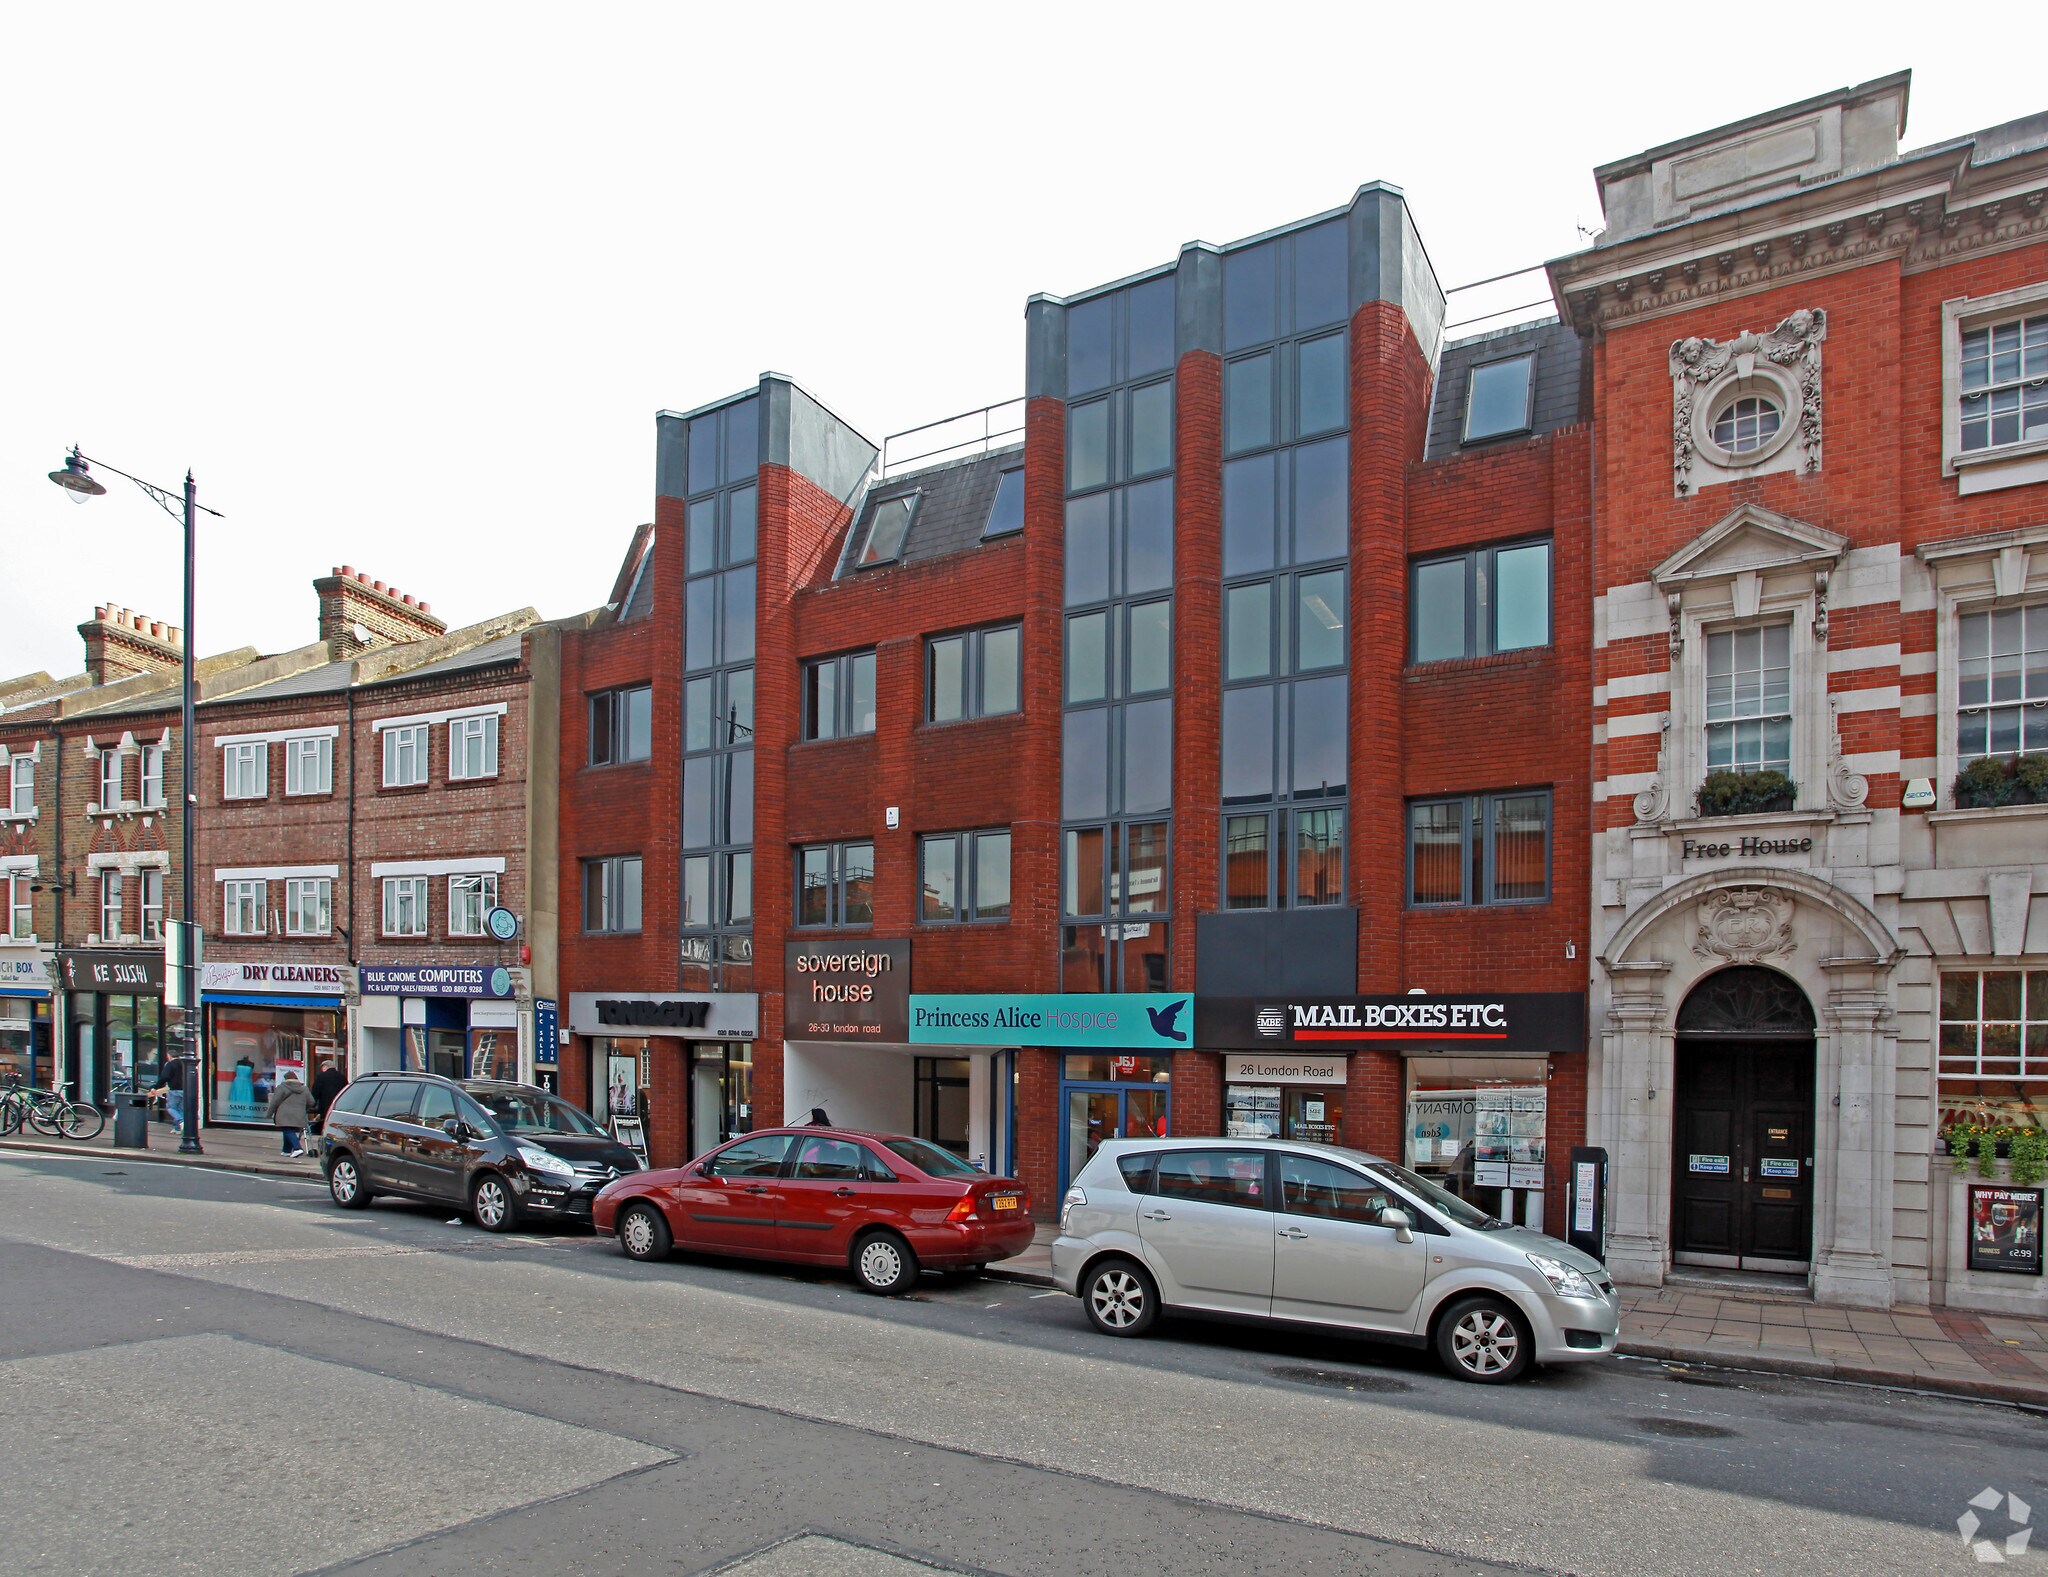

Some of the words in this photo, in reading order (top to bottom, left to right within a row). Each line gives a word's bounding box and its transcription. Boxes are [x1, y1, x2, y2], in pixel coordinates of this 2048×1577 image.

[1906, 791, 1932, 799] SECOM
[1681, 839, 1730, 859] Free
[1739, 836, 1812, 856] House
[1726, 917, 1761, 934] ER
[16, 961, 34, 973] BOX
[797, 950, 891, 978] sovereign
[94, 963, 110, 982] KE
[114, 964, 148, 984] SUSHI
[242, 965, 269, 981] DRY
[271, 966, 341, 983] CLEANERS
[367, 972, 386, 982] BLUE
[388, 972, 417, 982] GNOME
[419, 969, 483, 983] COMPUTERS
[381, 984, 400, 992] LAPTOP
[401, 985, 438, 993] SALES/REPAIRS
[813, 979, 873, 1002] house
[596, 1000, 711, 1028] TONI&GUY
[915, 1008, 989, 1027] Princess
[993, 1008, 1041, 1028] Alice
[1046, 1009, 1119, 1034] Hospice
[1294, 1005, 1361, 1027] MAIL
[1365, 1005, 1447, 1027] BOXES
[1450, 1004, 1508, 1027] ETC.
[808, 1022, 830, 1033] 26-30
[833, 1023, 858, 1033] london
[863, 1023, 881, 1033] road
[1260, 1017, 1281, 1027] MBE
[1240, 1064, 1254, 1075] 26
[1258, 1065, 1299, 1077] London
[1303, 1066, 1334, 1078] Road
[229, 1104, 261, 1112] SAME-DAY
[1975, 1190, 1993, 1200] WHY
[1994, 1191, 2010, 1201] PAY
[2010, 1192, 2037, 1202] MORE?
